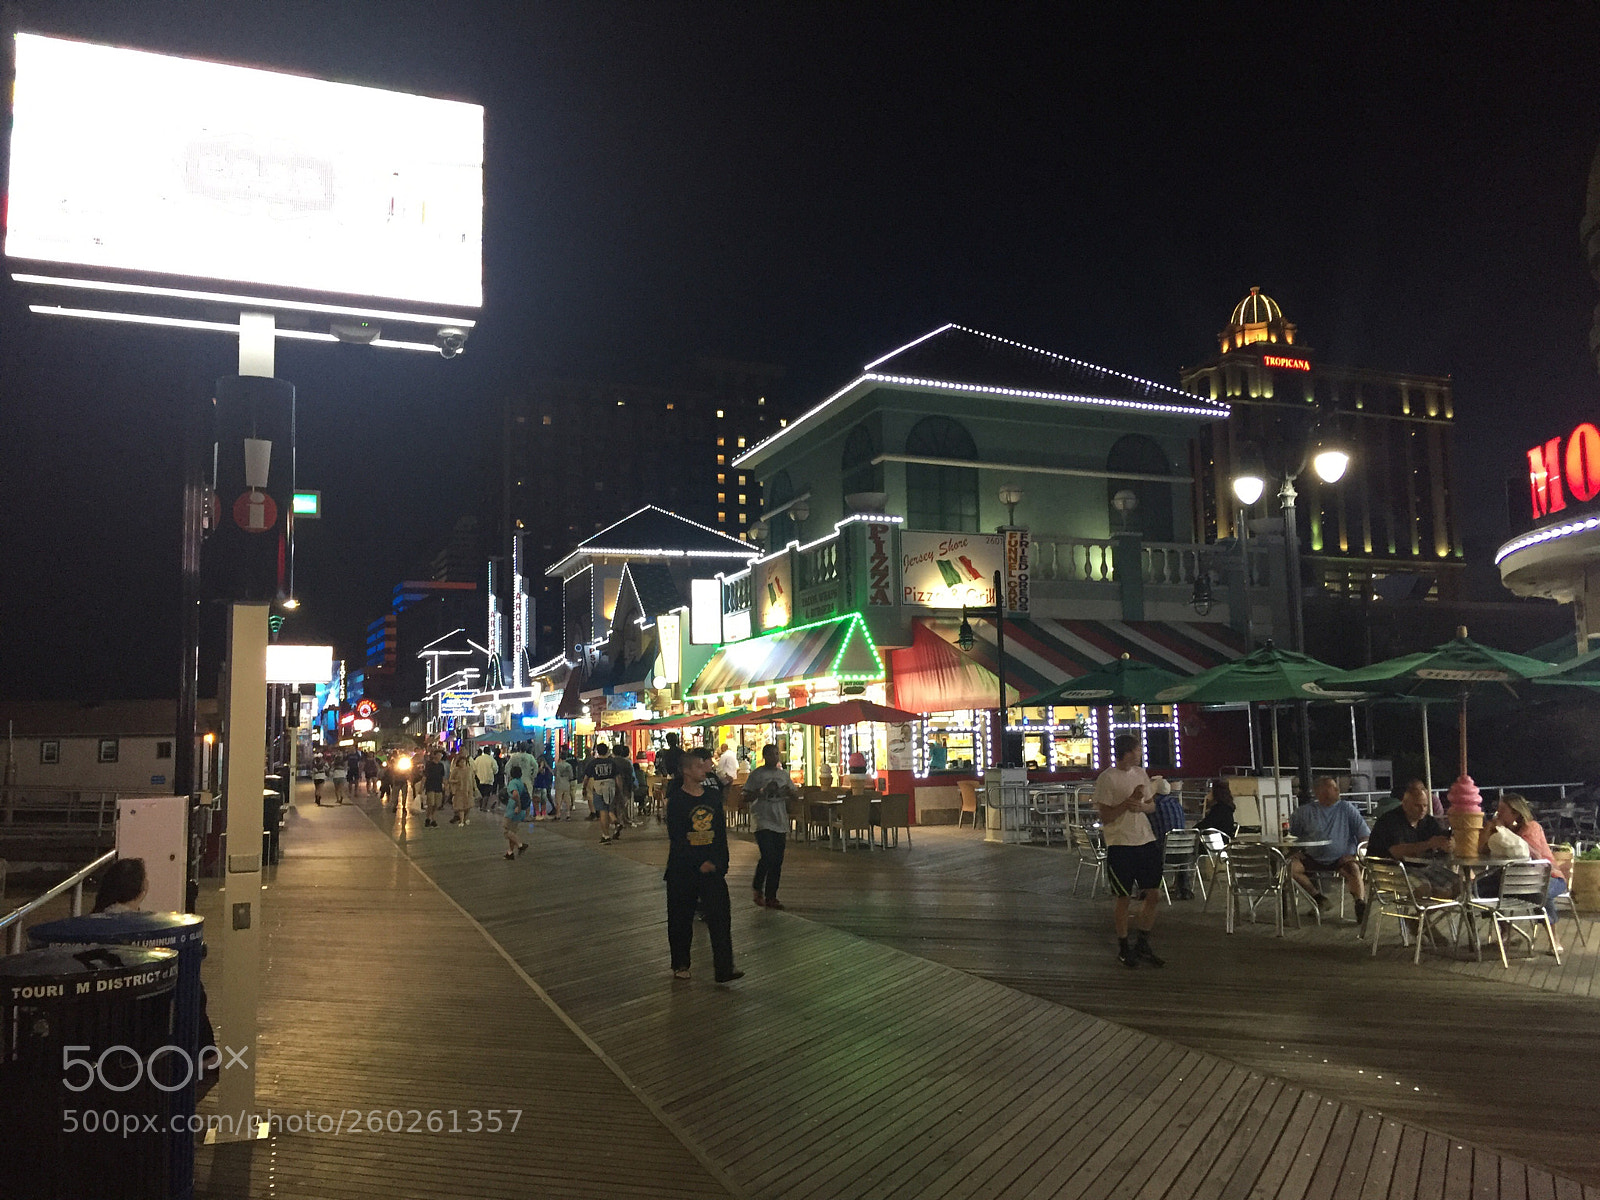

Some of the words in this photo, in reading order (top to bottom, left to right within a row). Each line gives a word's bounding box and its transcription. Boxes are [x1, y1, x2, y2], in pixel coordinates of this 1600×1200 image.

[1264, 355, 1310, 371] TROPICANA
[868, 524, 892, 605] PIZZA
[903, 552, 934, 573] Jersey
[938, 537, 969, 556] Shore
[1008, 533, 1018, 577] FUNNEL
[1018, 533, 1029, 570] FRIED
[904, 587, 944, 602] Pizz
[1007, 581, 1018, 611] CAKE
[1018, 574, 1029, 611] OREOS
[12, 981, 90, 1000] TOURIM
[96, 970, 161, 992] DISTRICT
